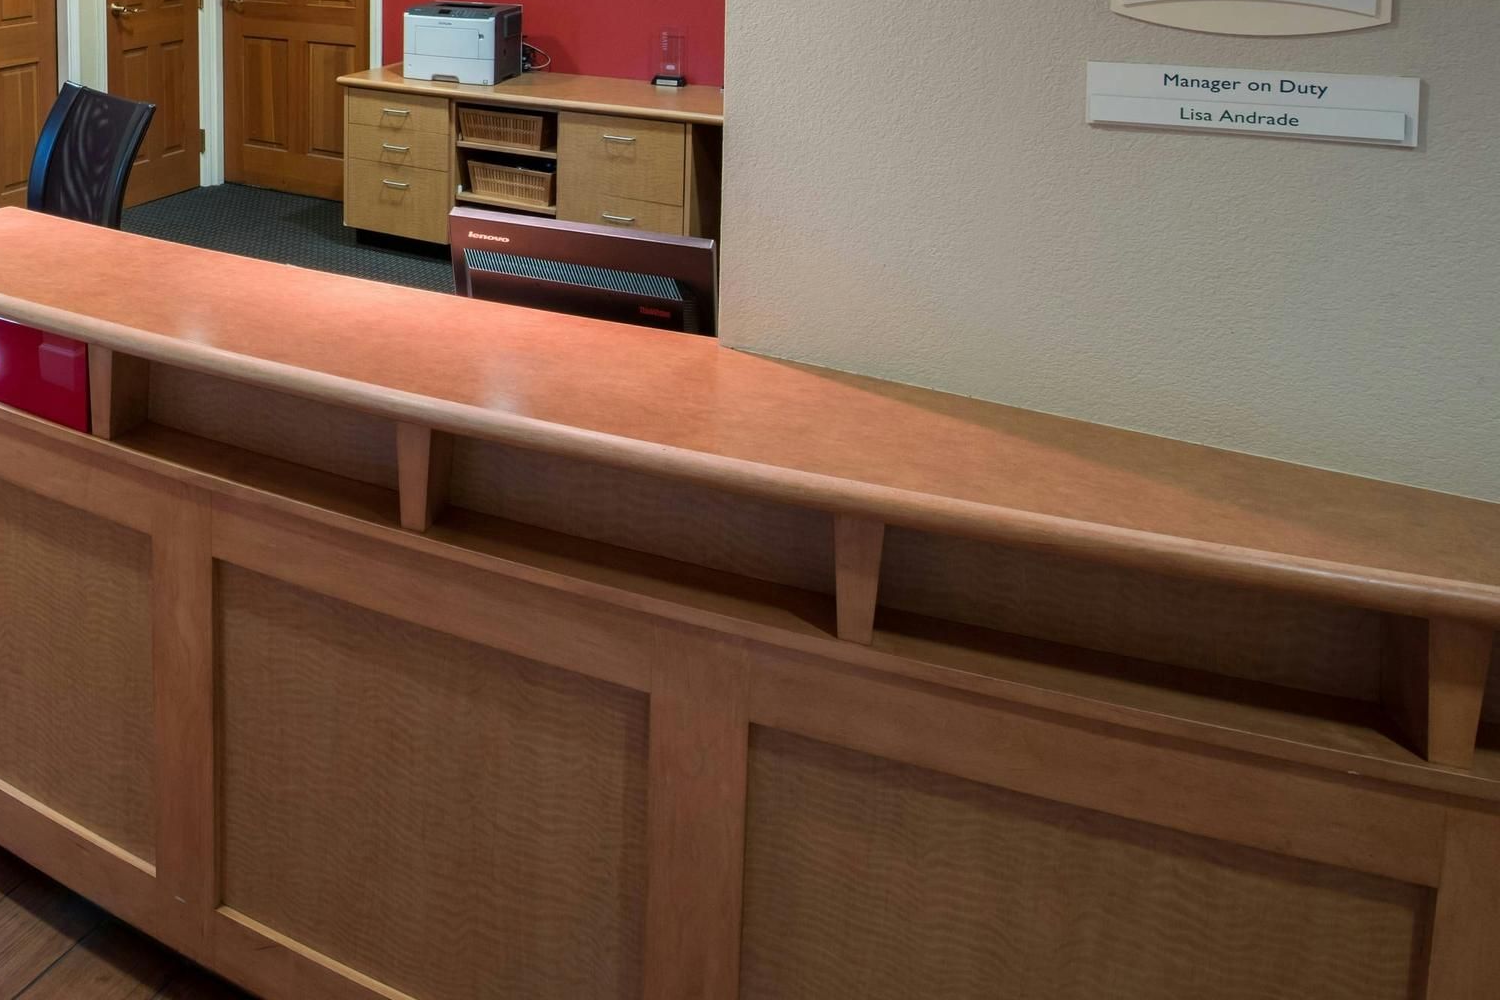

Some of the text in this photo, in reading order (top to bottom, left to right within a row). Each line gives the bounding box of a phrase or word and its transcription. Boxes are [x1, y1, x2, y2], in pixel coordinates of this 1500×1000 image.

[1163, 73, 1329, 99] Manager on Duty
[1179, 107, 1300, 127] Lisa Andrade
[468, 231, 510, 242] lenovo
